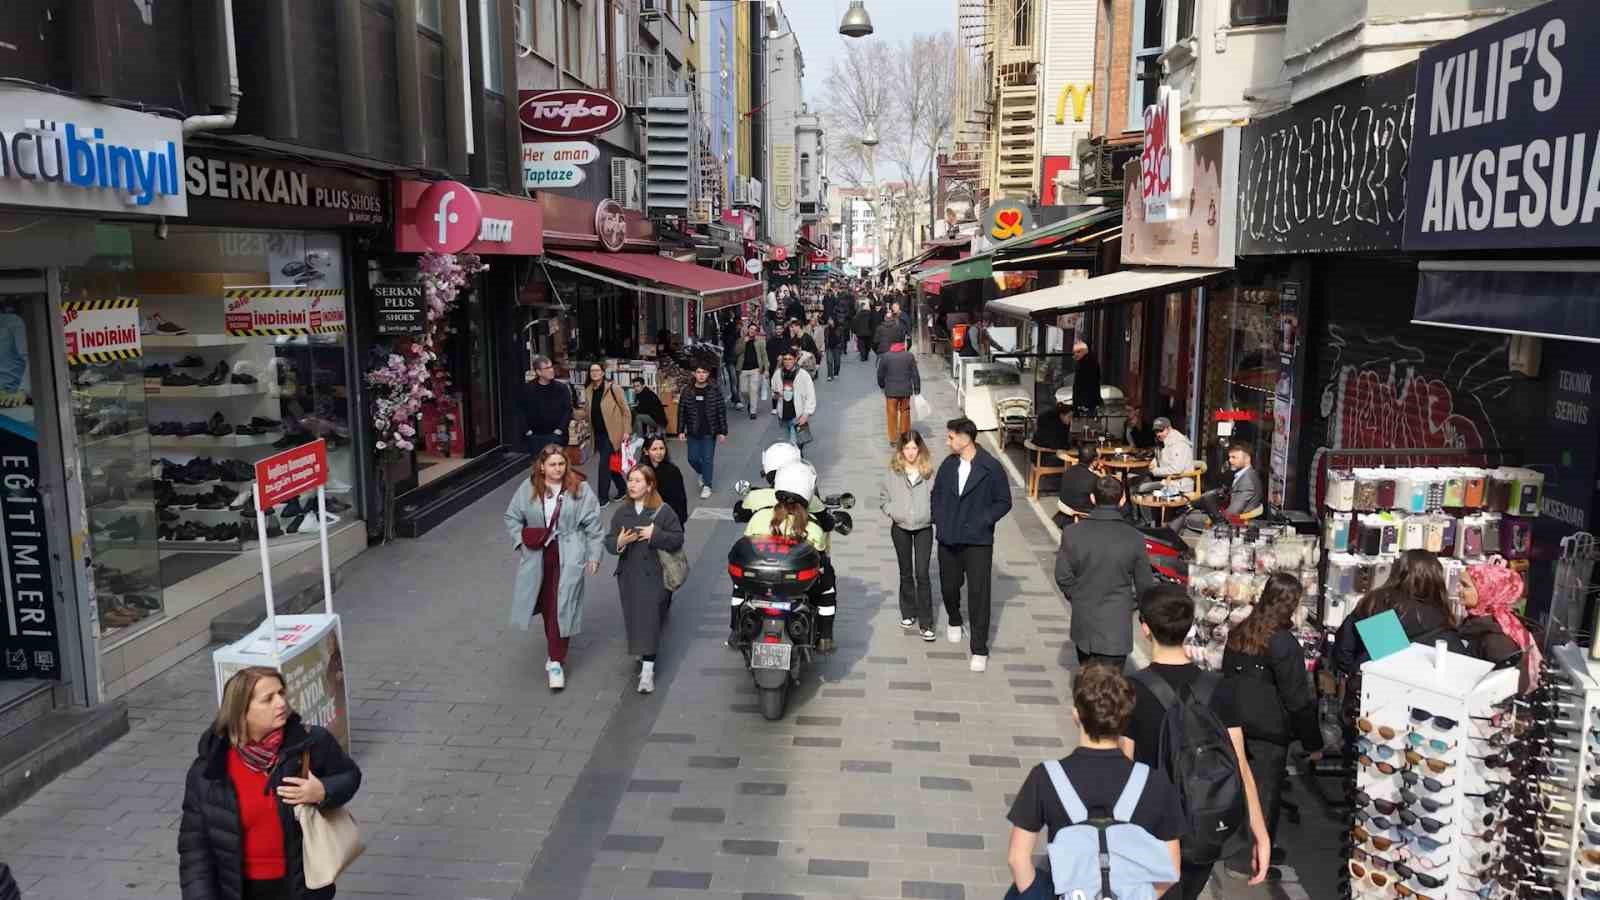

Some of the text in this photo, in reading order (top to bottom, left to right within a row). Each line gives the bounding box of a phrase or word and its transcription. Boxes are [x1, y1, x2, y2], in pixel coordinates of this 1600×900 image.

[1429, 18, 1566, 136] KILIF'S
[523, 148, 545, 161] Her
[185, 155, 382, 212] SERKAN PLUS SHOES
[524, 168, 574, 184] Taptaze
[375, 287, 422, 297] SERKAN
[384, 298, 416, 308] PLUS
[253, 308, 307, 326] İNDİRİMİ
[385, 313, 415, 321] SHOES
[80, 323, 137, 349] İNDİRİMİ
[1559, 369, 1593, 394] TEKNİK
[1555, 399, 1589, 425] SERVİS
[2, 455, 52, 637] EĞİTİMLERİ
